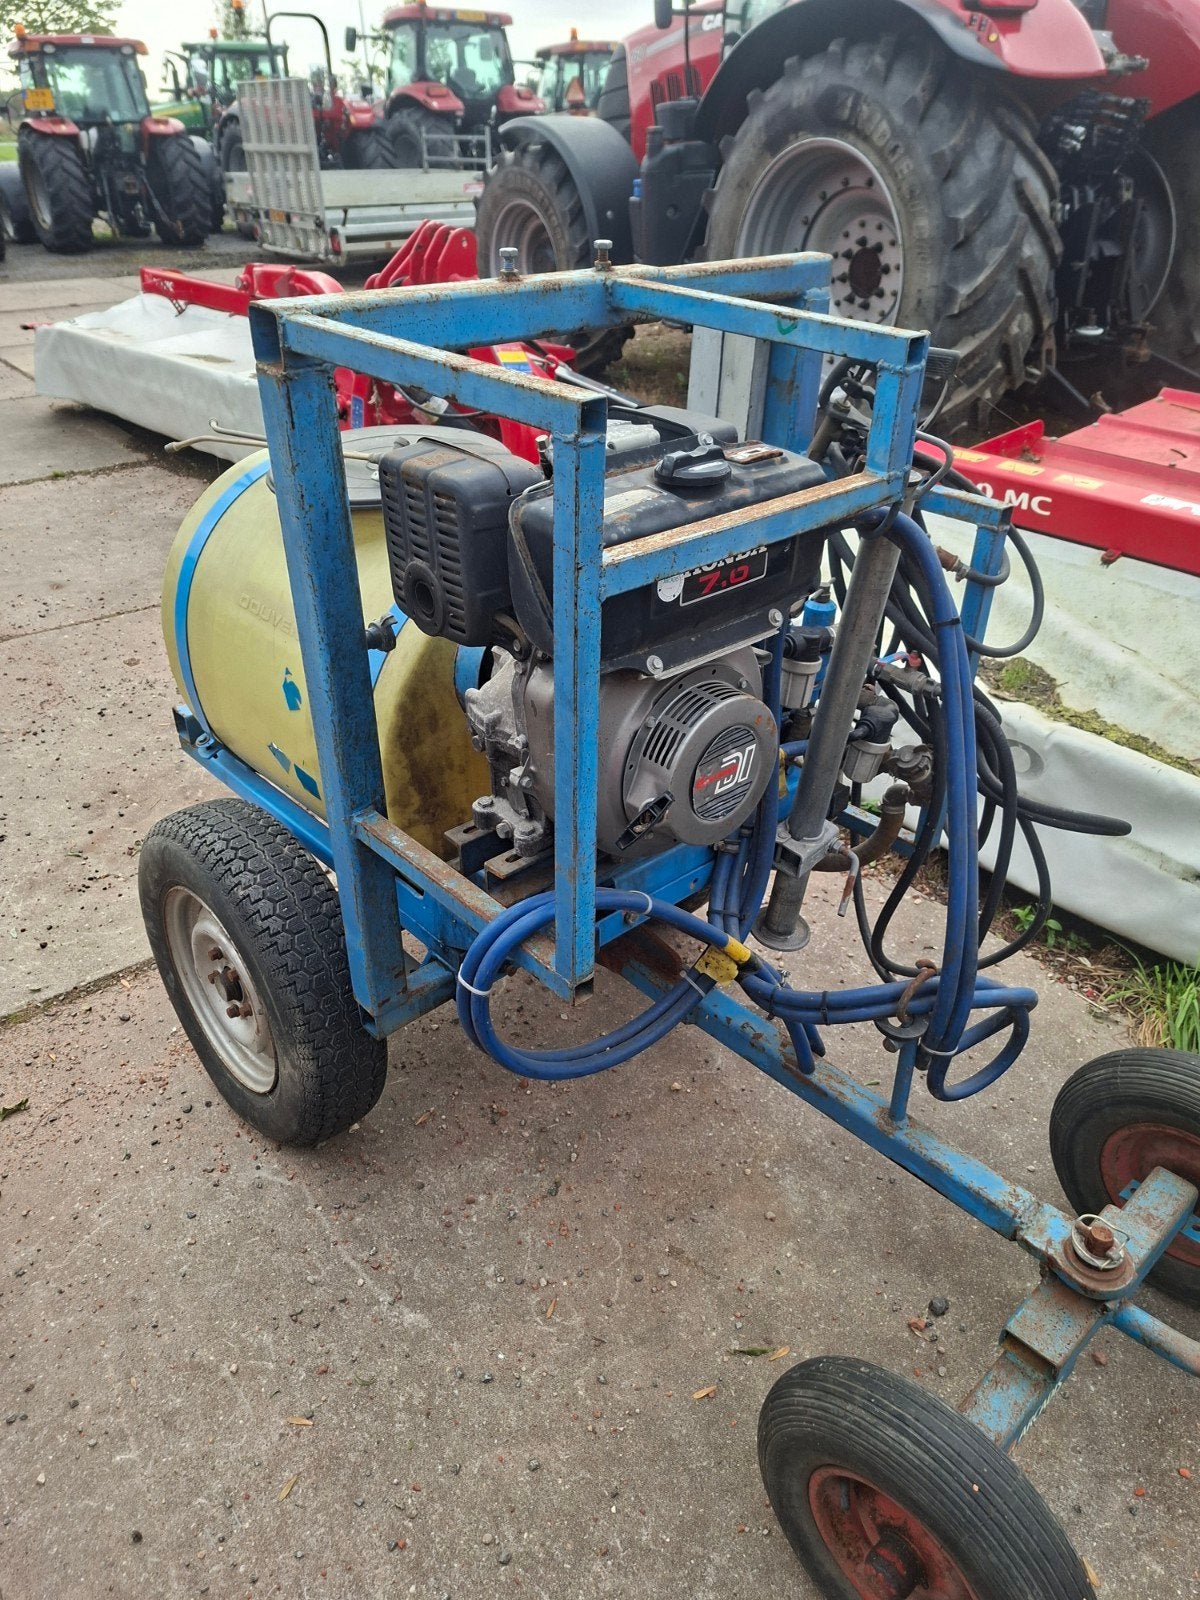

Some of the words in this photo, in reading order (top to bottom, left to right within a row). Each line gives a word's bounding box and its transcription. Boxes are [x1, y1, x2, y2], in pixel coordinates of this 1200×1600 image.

[702, 12, 723, 31] CA
[1003, 488, 1053, 516] MC
[699, 564, 750, 596] 7.0
